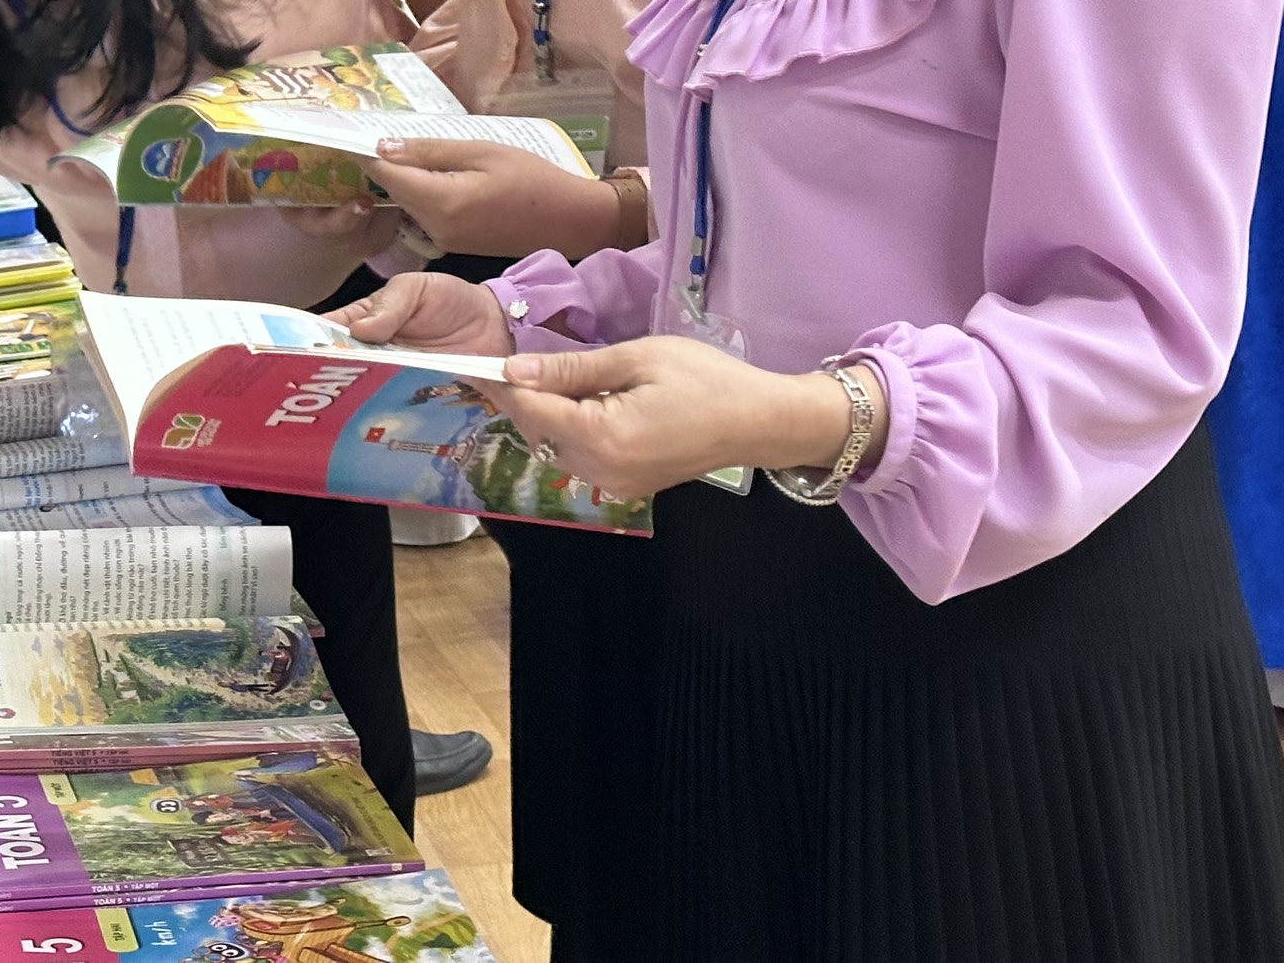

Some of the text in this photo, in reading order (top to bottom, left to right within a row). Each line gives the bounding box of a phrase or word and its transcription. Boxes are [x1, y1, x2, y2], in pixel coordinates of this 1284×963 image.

[264, 366, 368, 427] TOÁN
[92, 884, 114, 893] TOÁN
[94, 897, 116, 905] TOÁN
[20, 938, 83, 954] 5
